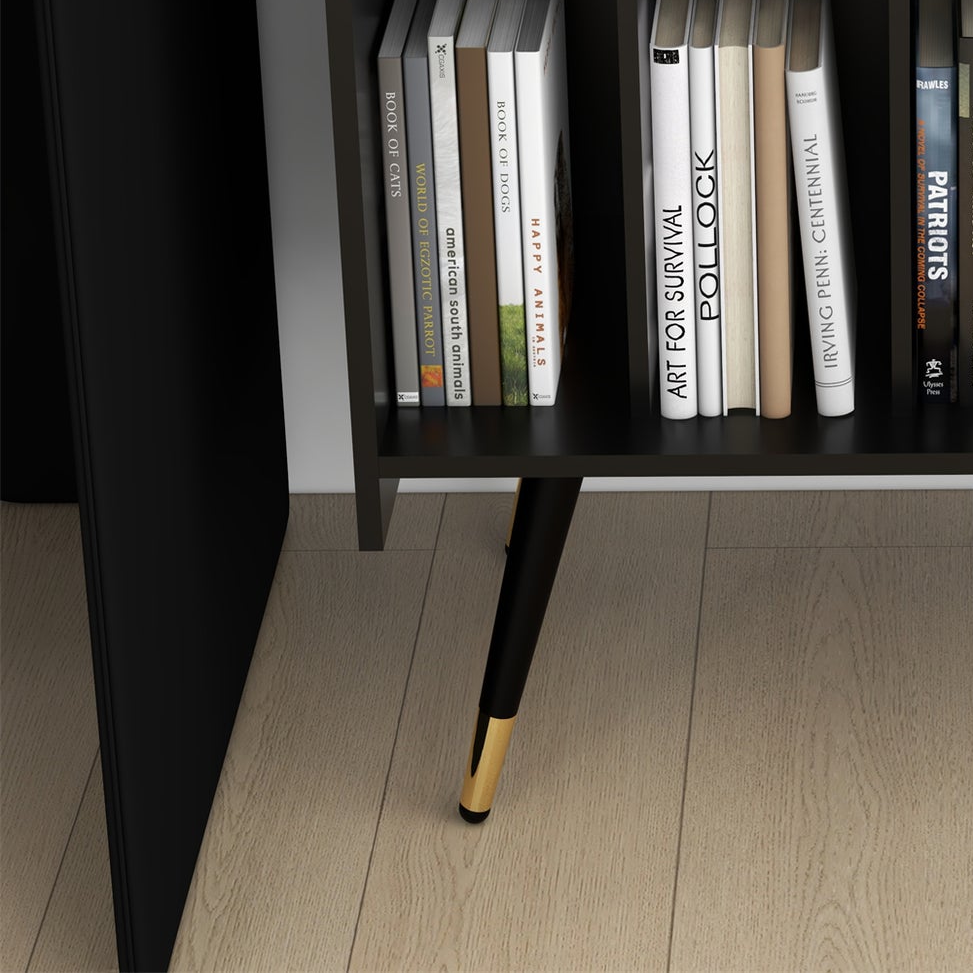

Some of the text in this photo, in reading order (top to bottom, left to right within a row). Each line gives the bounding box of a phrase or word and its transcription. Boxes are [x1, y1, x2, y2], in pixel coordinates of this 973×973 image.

[386, 92, 402, 198] BOOK OF CATS
[496, 101, 510, 213] BOOK OF DOGS
[918, 127, 926, 156] NOVEL
[918, 159, 926, 171] OF
[918, 173, 926, 214] SURVIVAL
[415, 163, 436, 357] WORLD OF EGZOTIC PARROT
[694, 149, 720, 321] POLLOCK
[803, 133, 839, 369] IRVING PENN: CENTENNIAL
[918, 216, 926, 226] IN
[918, 227, 926, 244] THE
[918, 246, 926, 283] COMING
[928, 171, 949, 281] PATRIOTS
[445, 227, 466, 400] american south animals
[531, 218, 546, 367] HAPPY ANIMALS
[662, 205, 688, 399] ART FOR SURVIVAL
[918, 284, 926, 330] COLLAPSE
